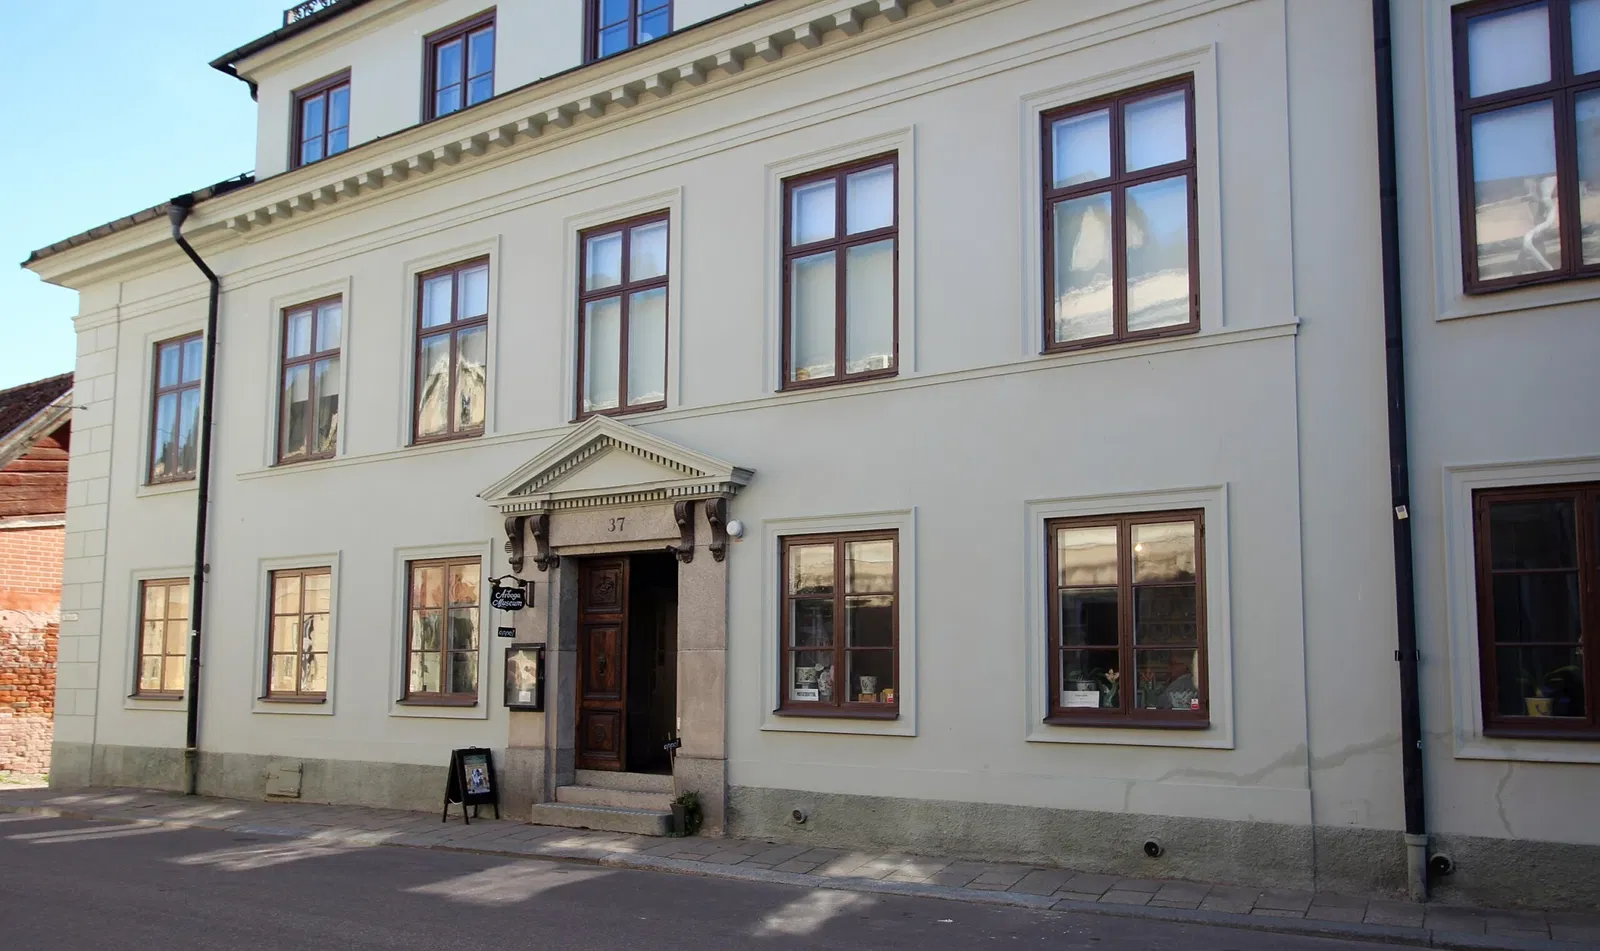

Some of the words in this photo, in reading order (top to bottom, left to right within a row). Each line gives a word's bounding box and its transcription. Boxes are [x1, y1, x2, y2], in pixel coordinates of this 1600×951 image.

[608, 517, 626, 533] 37
[495, 589, 521, 600] Arboga
[492, 599, 522, 608] Museum
